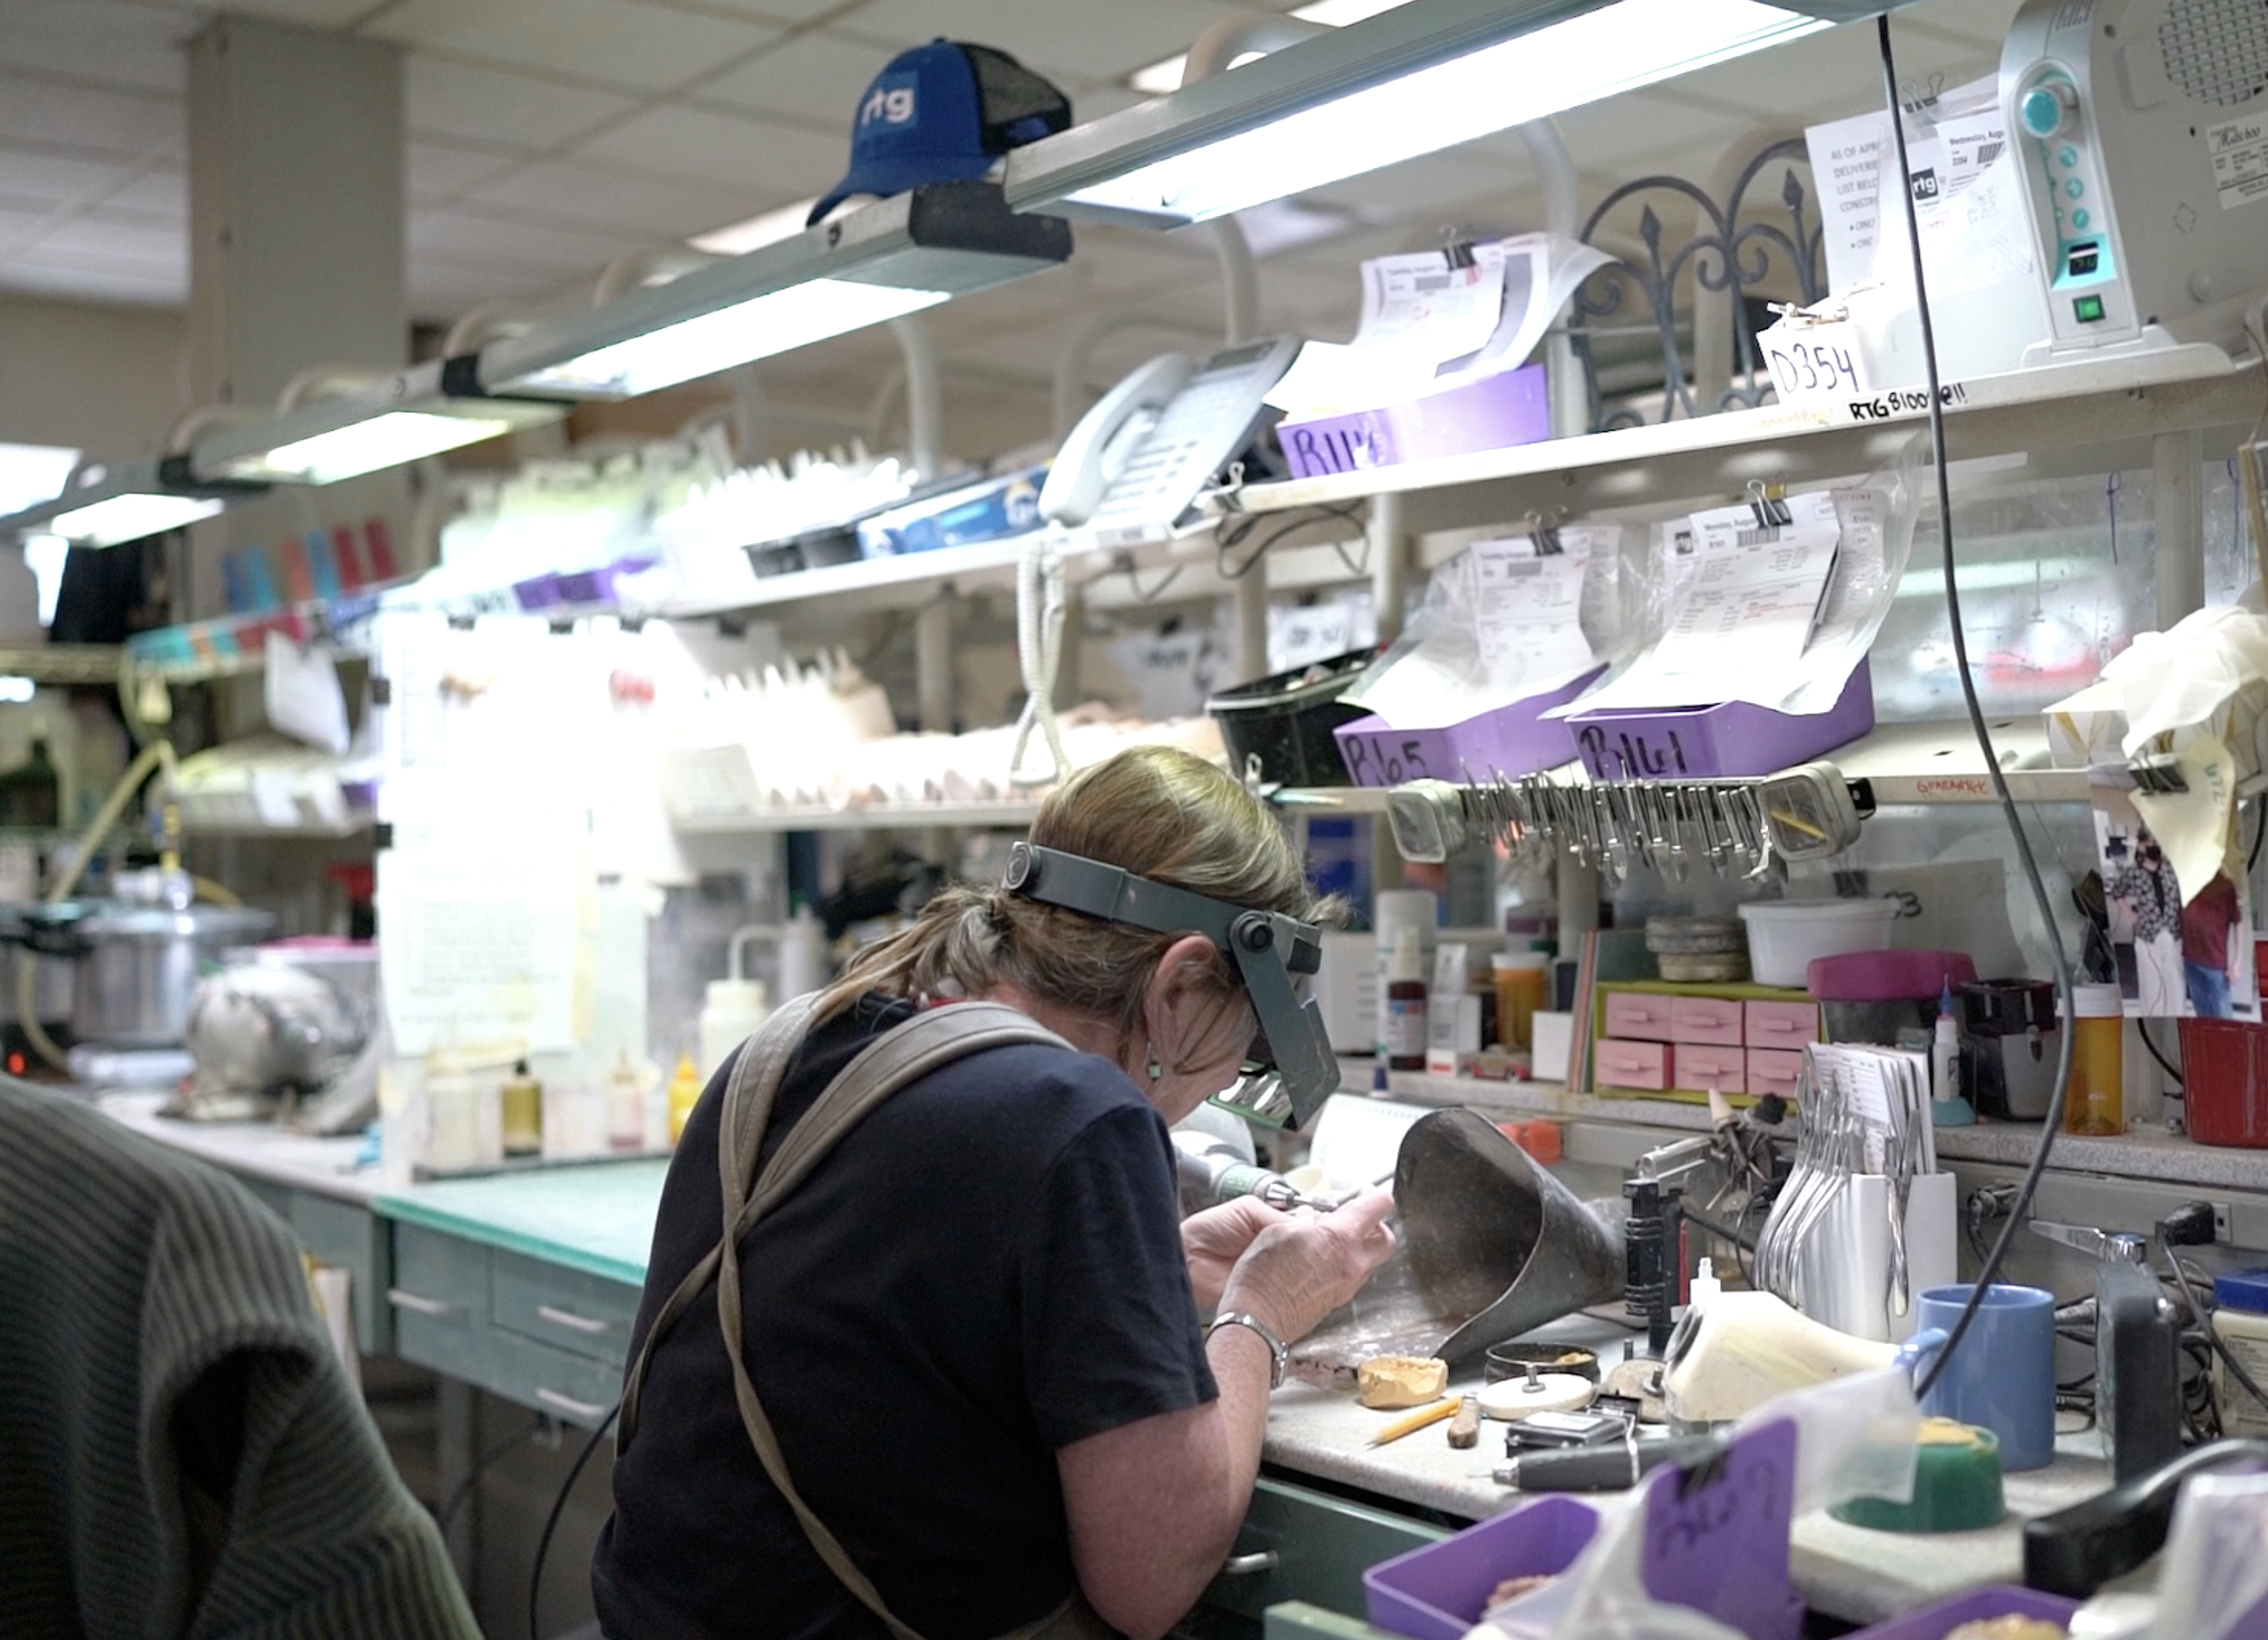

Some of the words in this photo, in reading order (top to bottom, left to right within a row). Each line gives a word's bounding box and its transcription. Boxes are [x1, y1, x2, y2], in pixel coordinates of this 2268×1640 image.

[861, 87, 914, 127] rtg
[1770, 342, 1860, 395] D354
[1850, 398, 1890, 421] RTG
